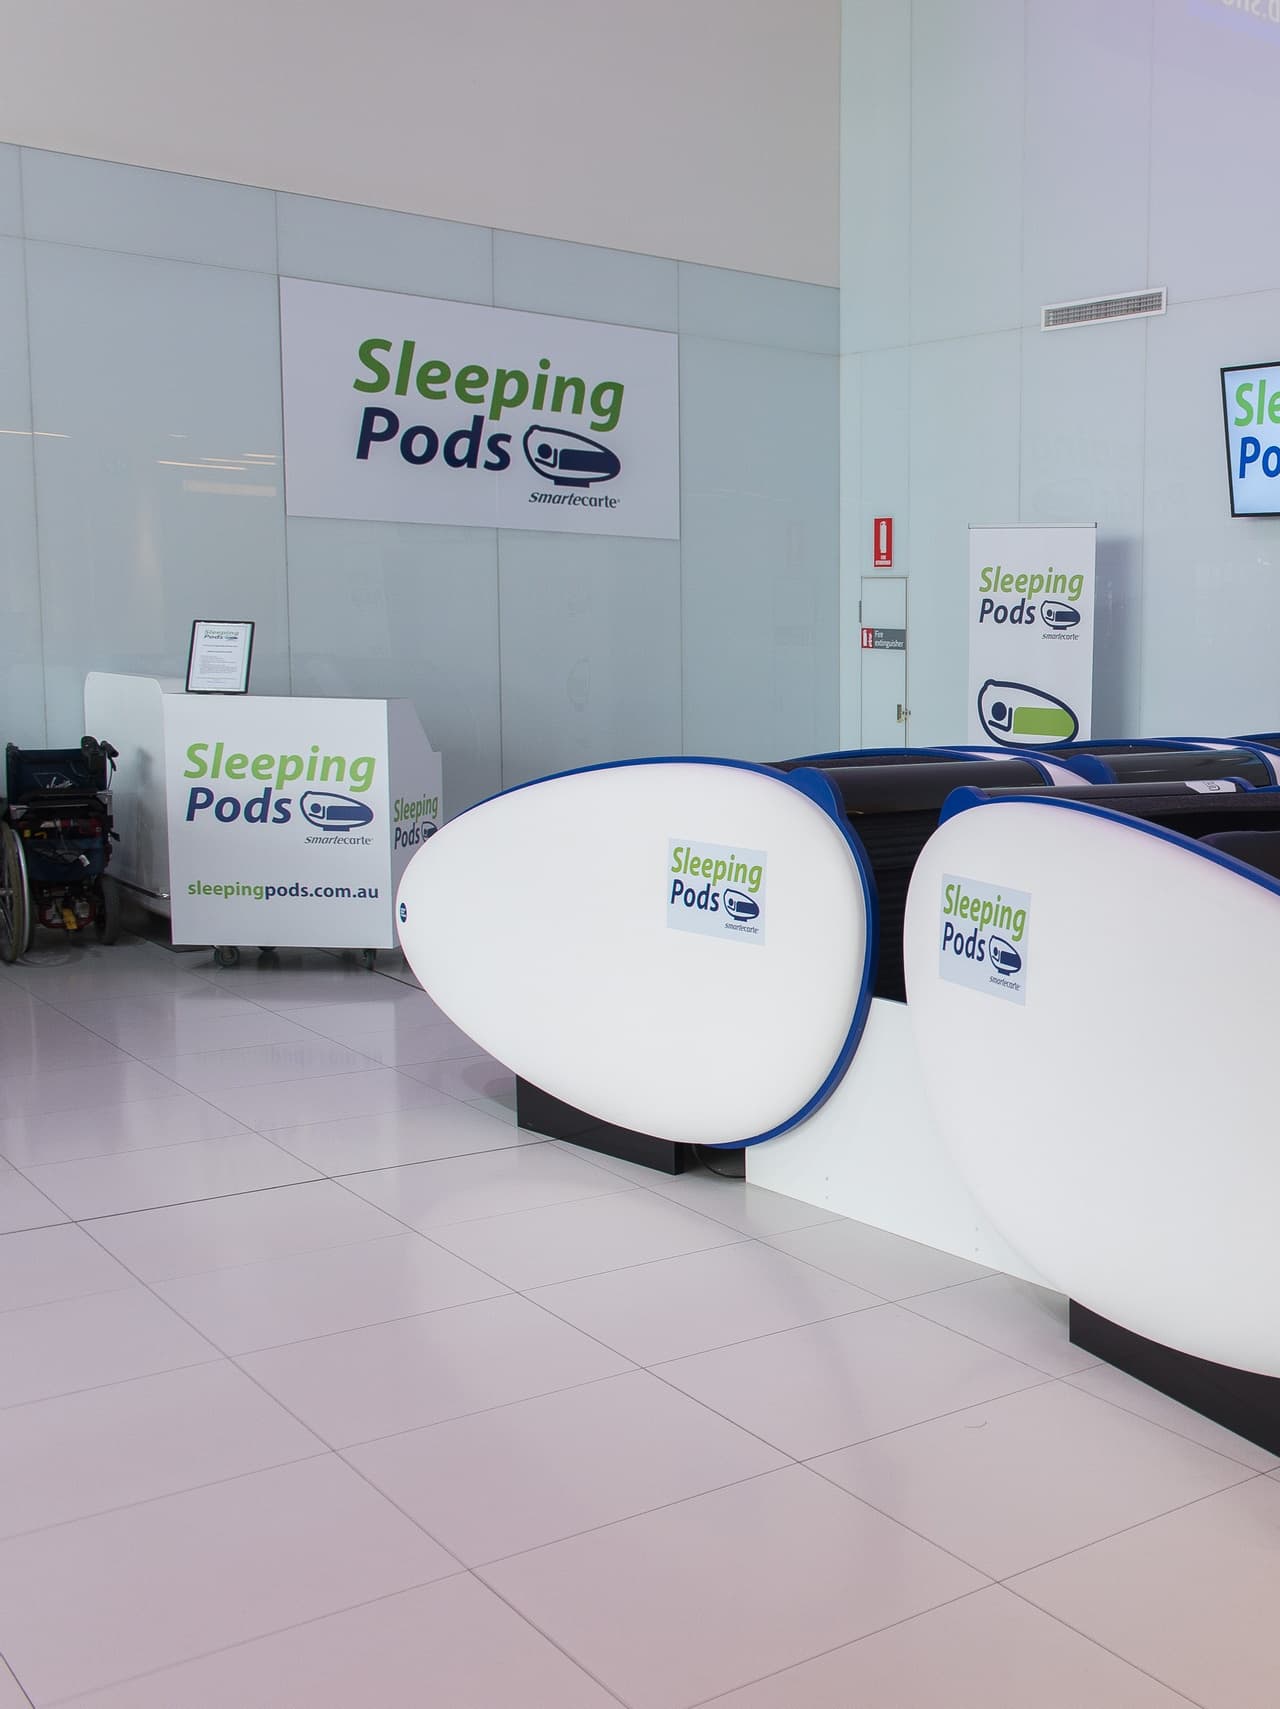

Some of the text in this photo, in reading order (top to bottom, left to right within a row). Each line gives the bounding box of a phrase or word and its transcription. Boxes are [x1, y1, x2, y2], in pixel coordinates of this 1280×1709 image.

[353, 338, 624, 432] Sleeping
[356, 407, 512, 471] Pods
[528, 491, 617, 509] smartecarte
[979, 566, 1084, 601] Sleeping
[979, 598, 1036, 624] Pods
[184, 742, 376, 793] Sleeping
[186, 787, 292, 824] Pods
[394, 793, 439, 823] Sleeping
[304, 836, 371, 846] smartecarte
[395, 822, 421, 850] Pods
[671, 846, 763, 893] Sleeping
[188, 881, 379, 900] sleepingpods.com.au
[670, 878, 720, 912] Pods
[943, 883, 1027, 942] Sleeping
[942, 921, 986, 962] Pods
